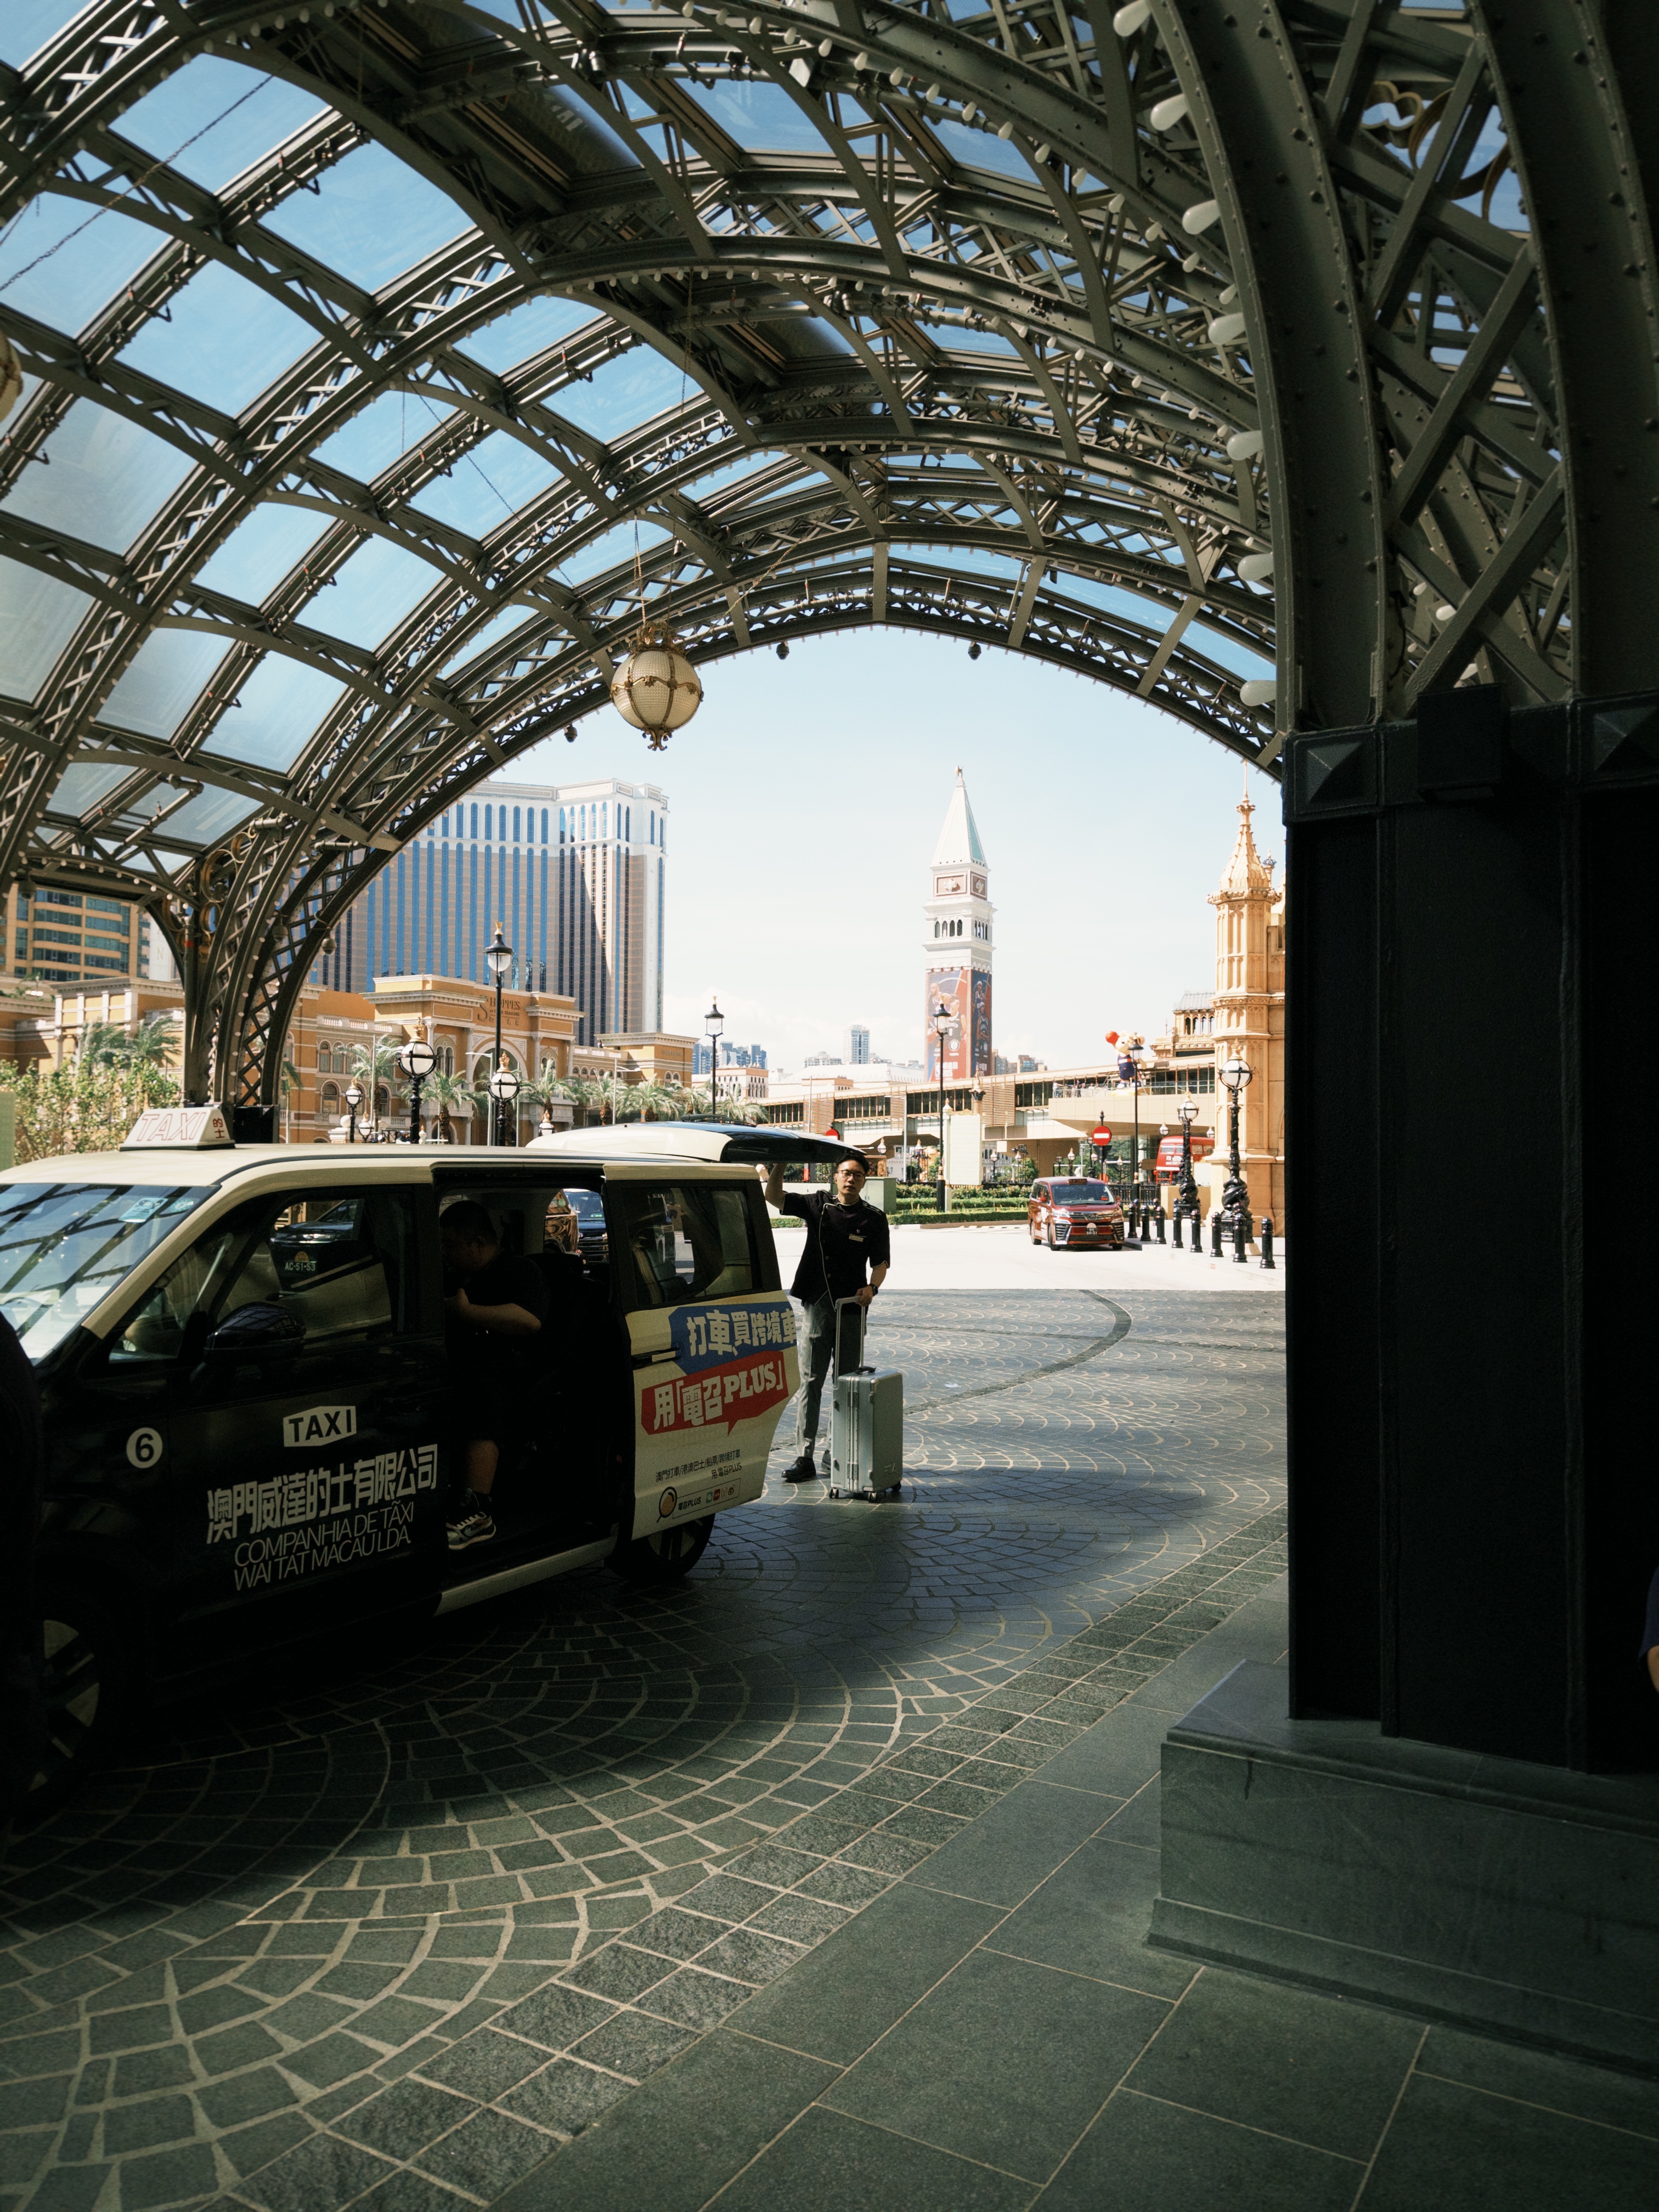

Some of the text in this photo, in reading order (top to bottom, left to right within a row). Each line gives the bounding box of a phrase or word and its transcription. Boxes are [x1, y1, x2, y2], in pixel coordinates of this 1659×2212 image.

[137, 1112, 206, 1141] TAXI
[212, 1118, 225, 1139] 的士
[285, 1262, 316, 1271] AC-51-53
[289, 1408, 353, 1443] TAXI
[135, 1433, 154, 1463] 6
[206, 1443, 438, 1545] 澳門威達的士有限公司
[234, 1518, 352, 1567] COMPANHIA
[354, 1510, 379, 1537] DE
[233, 1525, 411, 1592] WAI TAT MACAU LDA.
